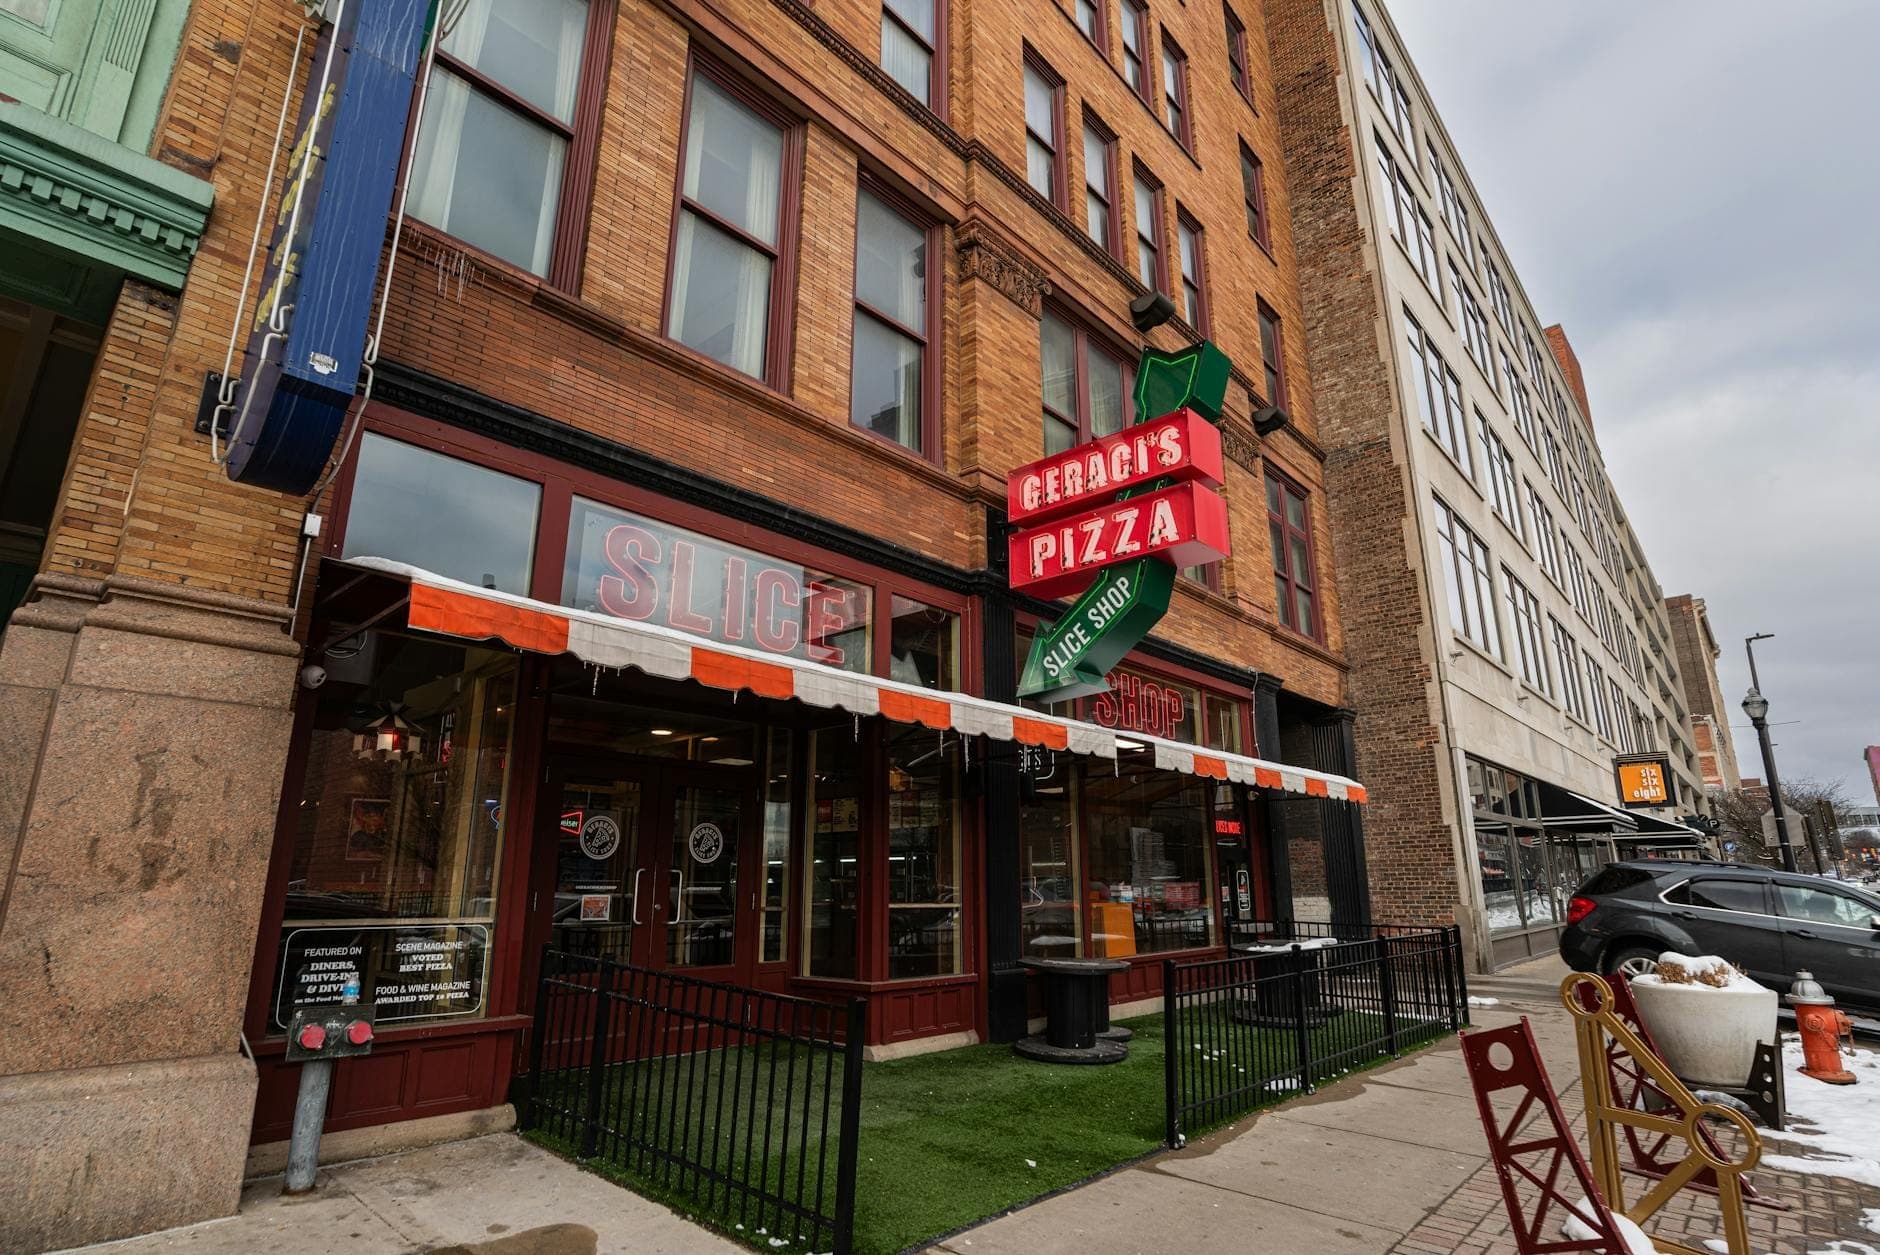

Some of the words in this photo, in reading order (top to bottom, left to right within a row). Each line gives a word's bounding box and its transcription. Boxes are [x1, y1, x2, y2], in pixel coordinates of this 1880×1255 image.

[1019, 425, 1183, 512] GERACI'S
[1028, 498, 1180, 579] PIZZA
[600, 524, 846, 664] SLICE
[1043, 623, 1091, 678] SLICE
[1087, 575, 1131, 630] SHOP
[1096, 671, 1185, 740] SHOP
[1640, 766, 1657, 778] six
[1642, 776, 1659, 786] six
[1633, 785, 1661, 799] eight
[304, 946, 349, 957] FEATURED
[349, 946, 362, 955] ON
[395, 942, 422, 952] SCENE
[423, 941, 464, 951] MAGAZINE
[412, 953, 444, 962] VOTED
[310, 961, 356, 971] DINERS,
[399, 963, 424, 973] BEST
[425, 962, 453, 971] PIZZA
[306, 984, 317, 994] &
[375, 985, 399, 995] FOOD
[399, 985, 407, 993] &
[407, 983, 430, 993] WINE
[430, 981, 471, 991] MAGAZINE
[374, 995, 417, 1005] AWARDED
[418, 994, 434, 1002] TOP
[446, 991, 470, 999] PIZZA
